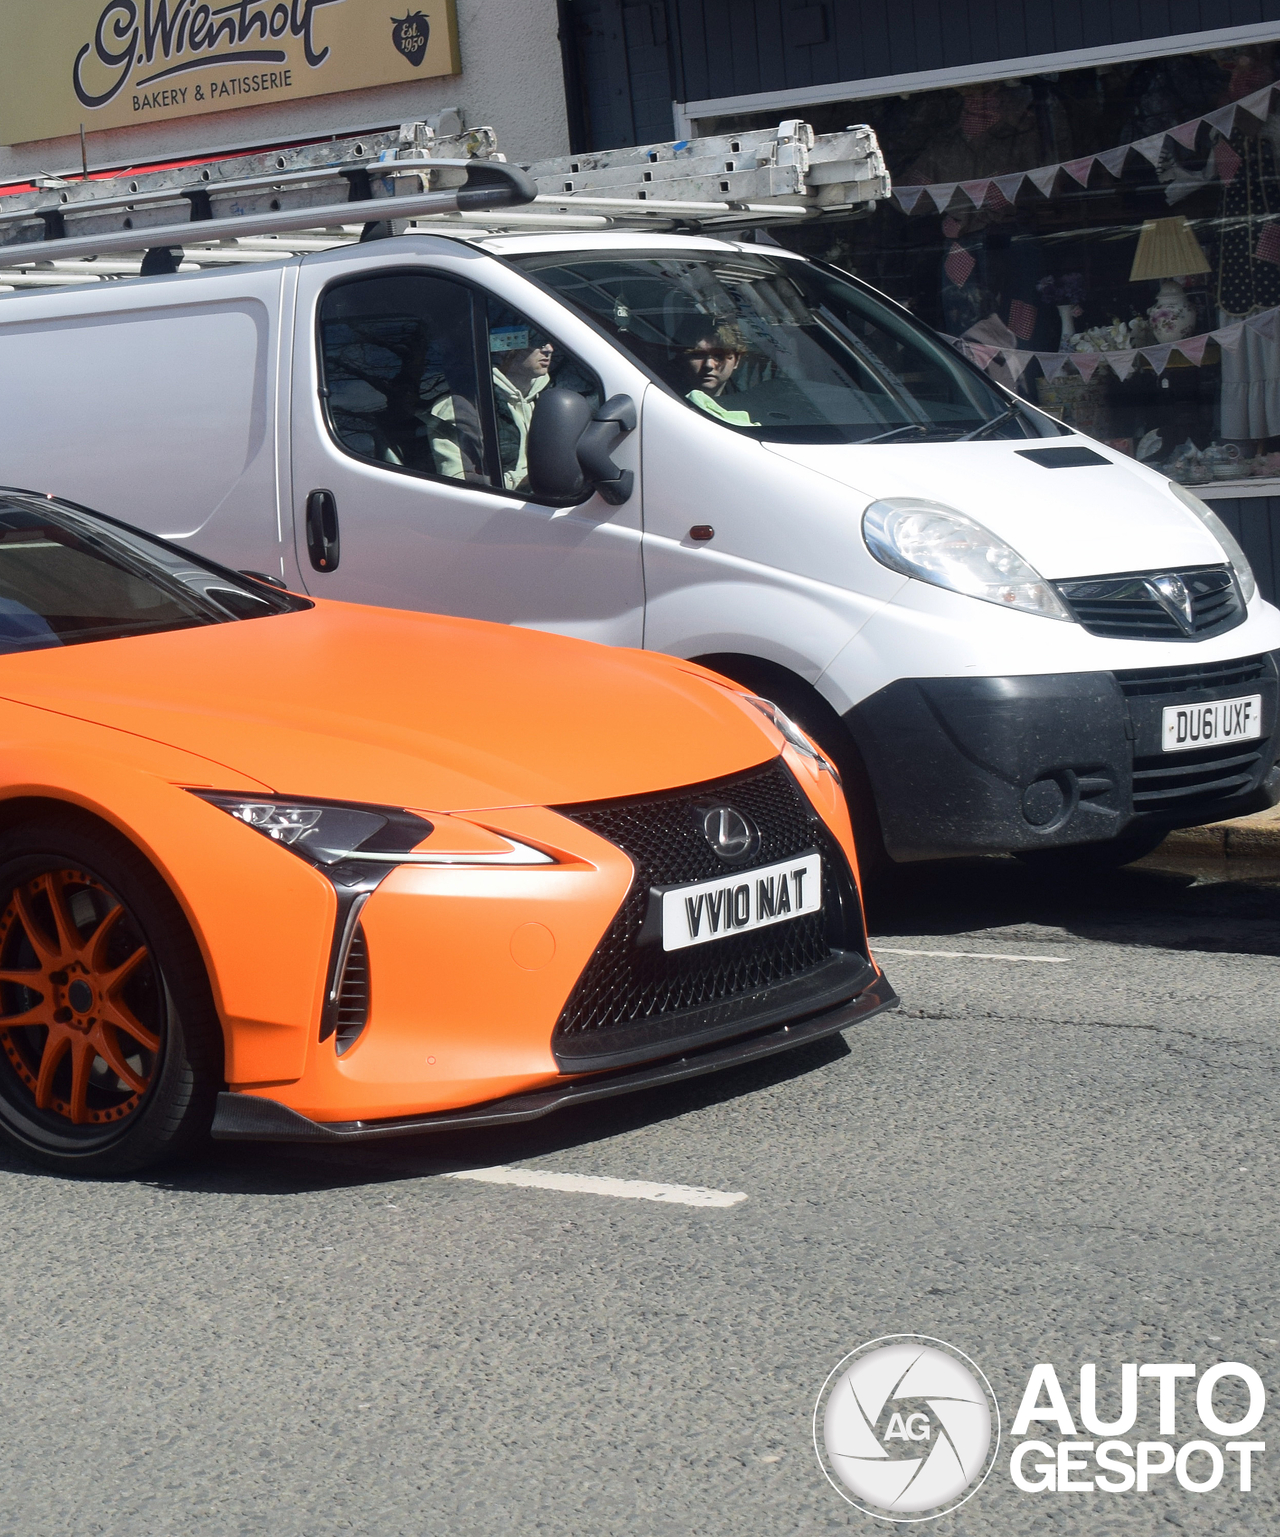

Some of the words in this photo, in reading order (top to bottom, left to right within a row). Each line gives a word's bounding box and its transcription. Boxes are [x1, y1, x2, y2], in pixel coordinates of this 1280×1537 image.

[401, 22, 420, 38] Est.
[401, 36, 424, 52] 1950
[132, 87, 188, 112] BAKERY
[194, 86, 205, 100] &
[210, 70, 292, 98] PATISSERIE
[1176, 707, 1218, 743] DU61
[1224, 702, 1252, 736] UXF
[685, 883, 750, 940] VV10
[756, 867, 807, 922] NAT
